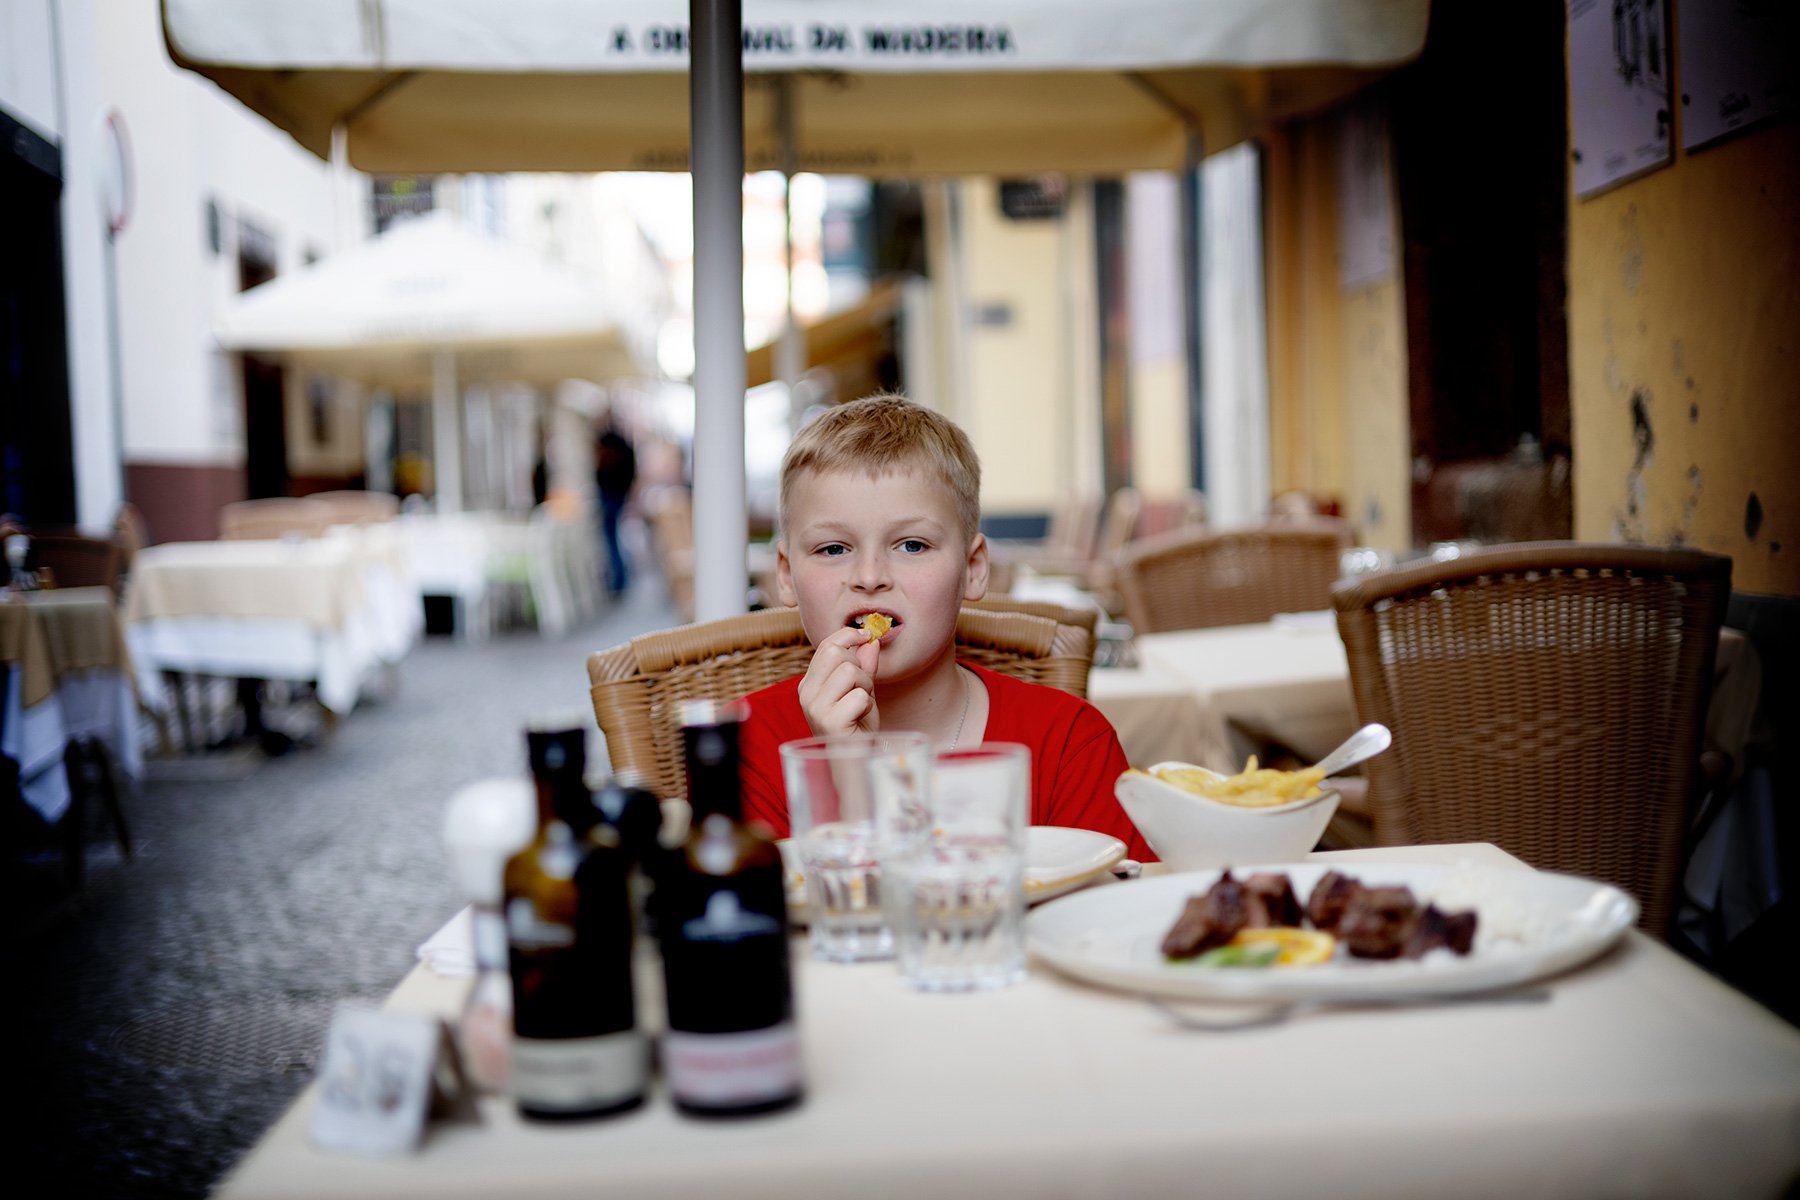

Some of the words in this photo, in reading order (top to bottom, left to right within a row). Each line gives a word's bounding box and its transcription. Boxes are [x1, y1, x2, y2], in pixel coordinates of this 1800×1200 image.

[608, 26, 633, 53] A
[643, 26, 797, 53] ORNAL
[808, 26, 849, 53] DA
[864, 25, 1018, 52] MADEIRA
